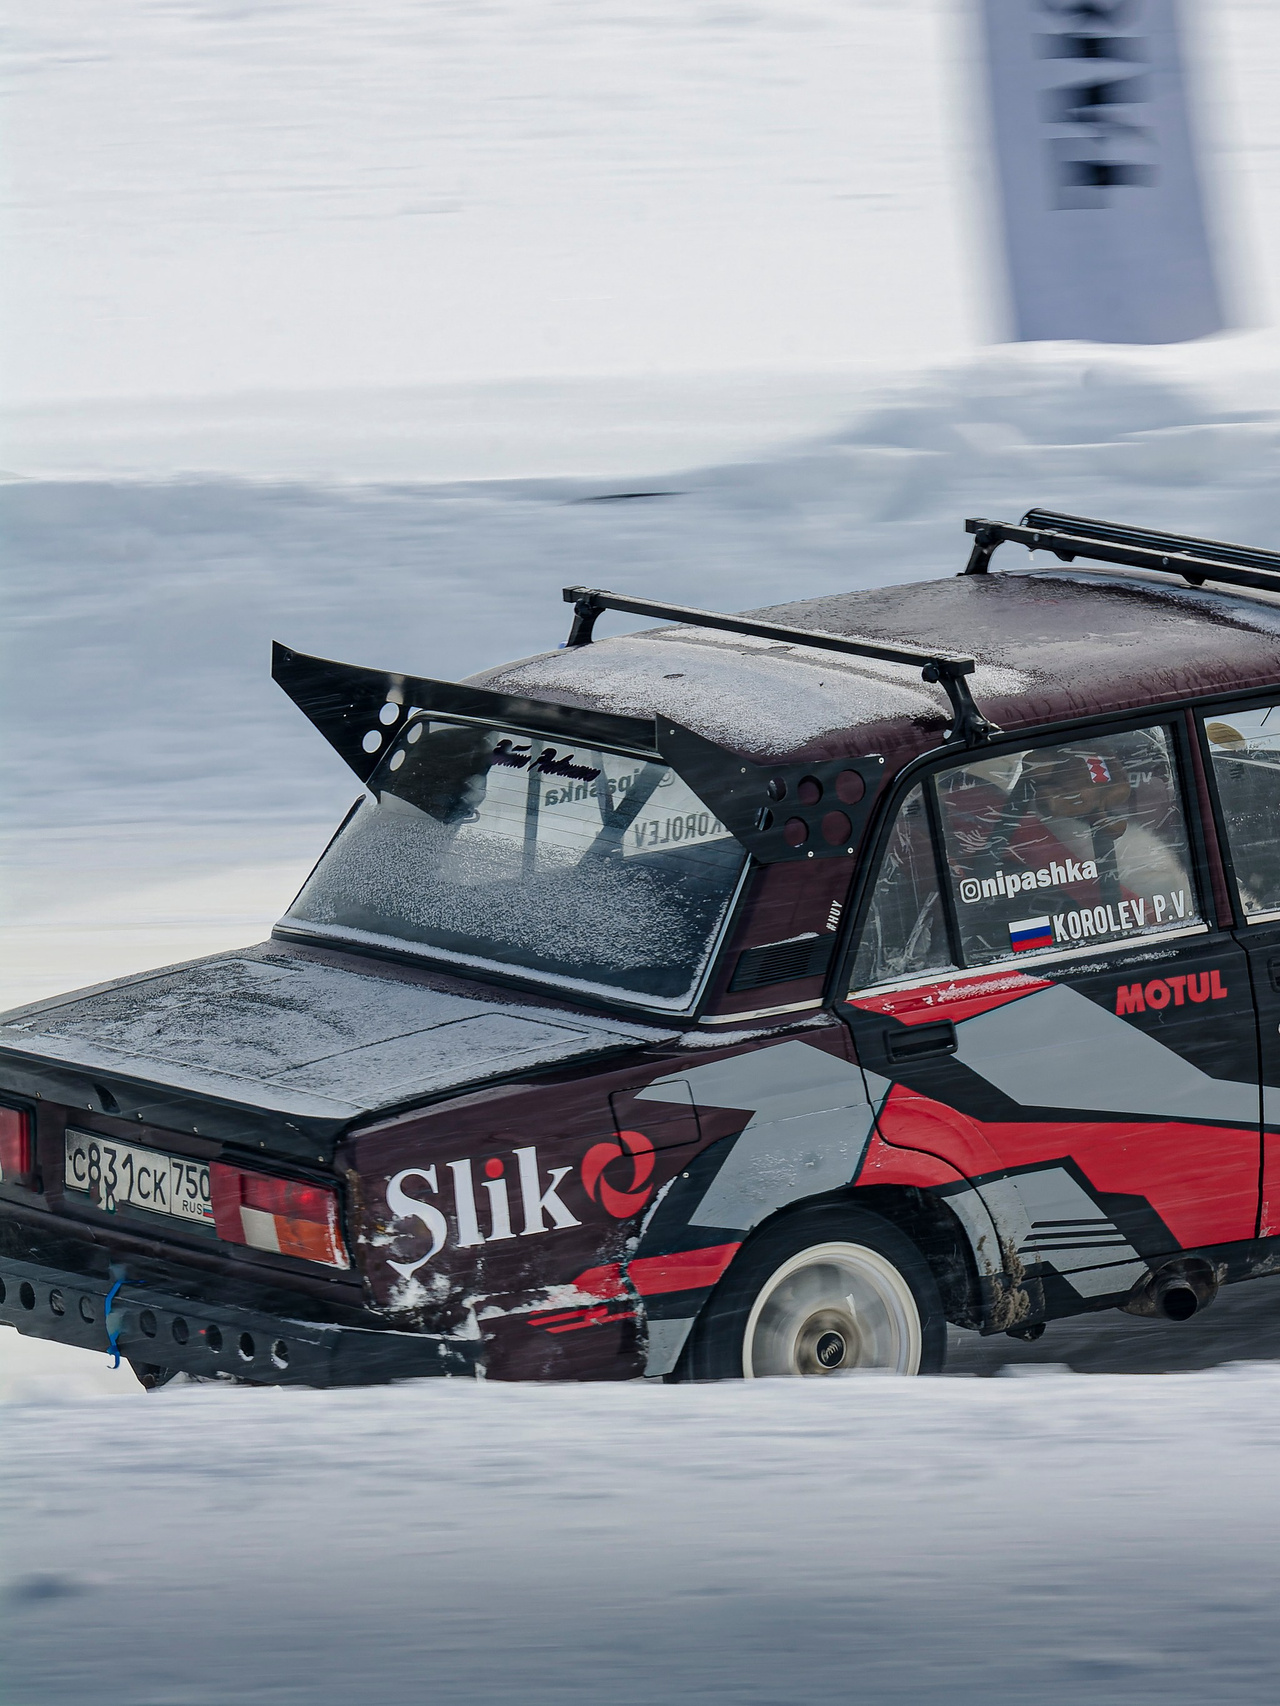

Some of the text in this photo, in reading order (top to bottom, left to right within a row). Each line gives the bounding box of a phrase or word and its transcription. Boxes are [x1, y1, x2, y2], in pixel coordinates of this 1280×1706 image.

[981, 858, 1098, 899] nipashka
[1052, 889, 1193, 942] KOROLEV P.V.
[1115, 970, 1228, 1015] MOTUL
[172, 1162, 211, 1202] 750
[182, 1199, 204, 1215] RUS
[384, 1146, 582, 1280] Slik
